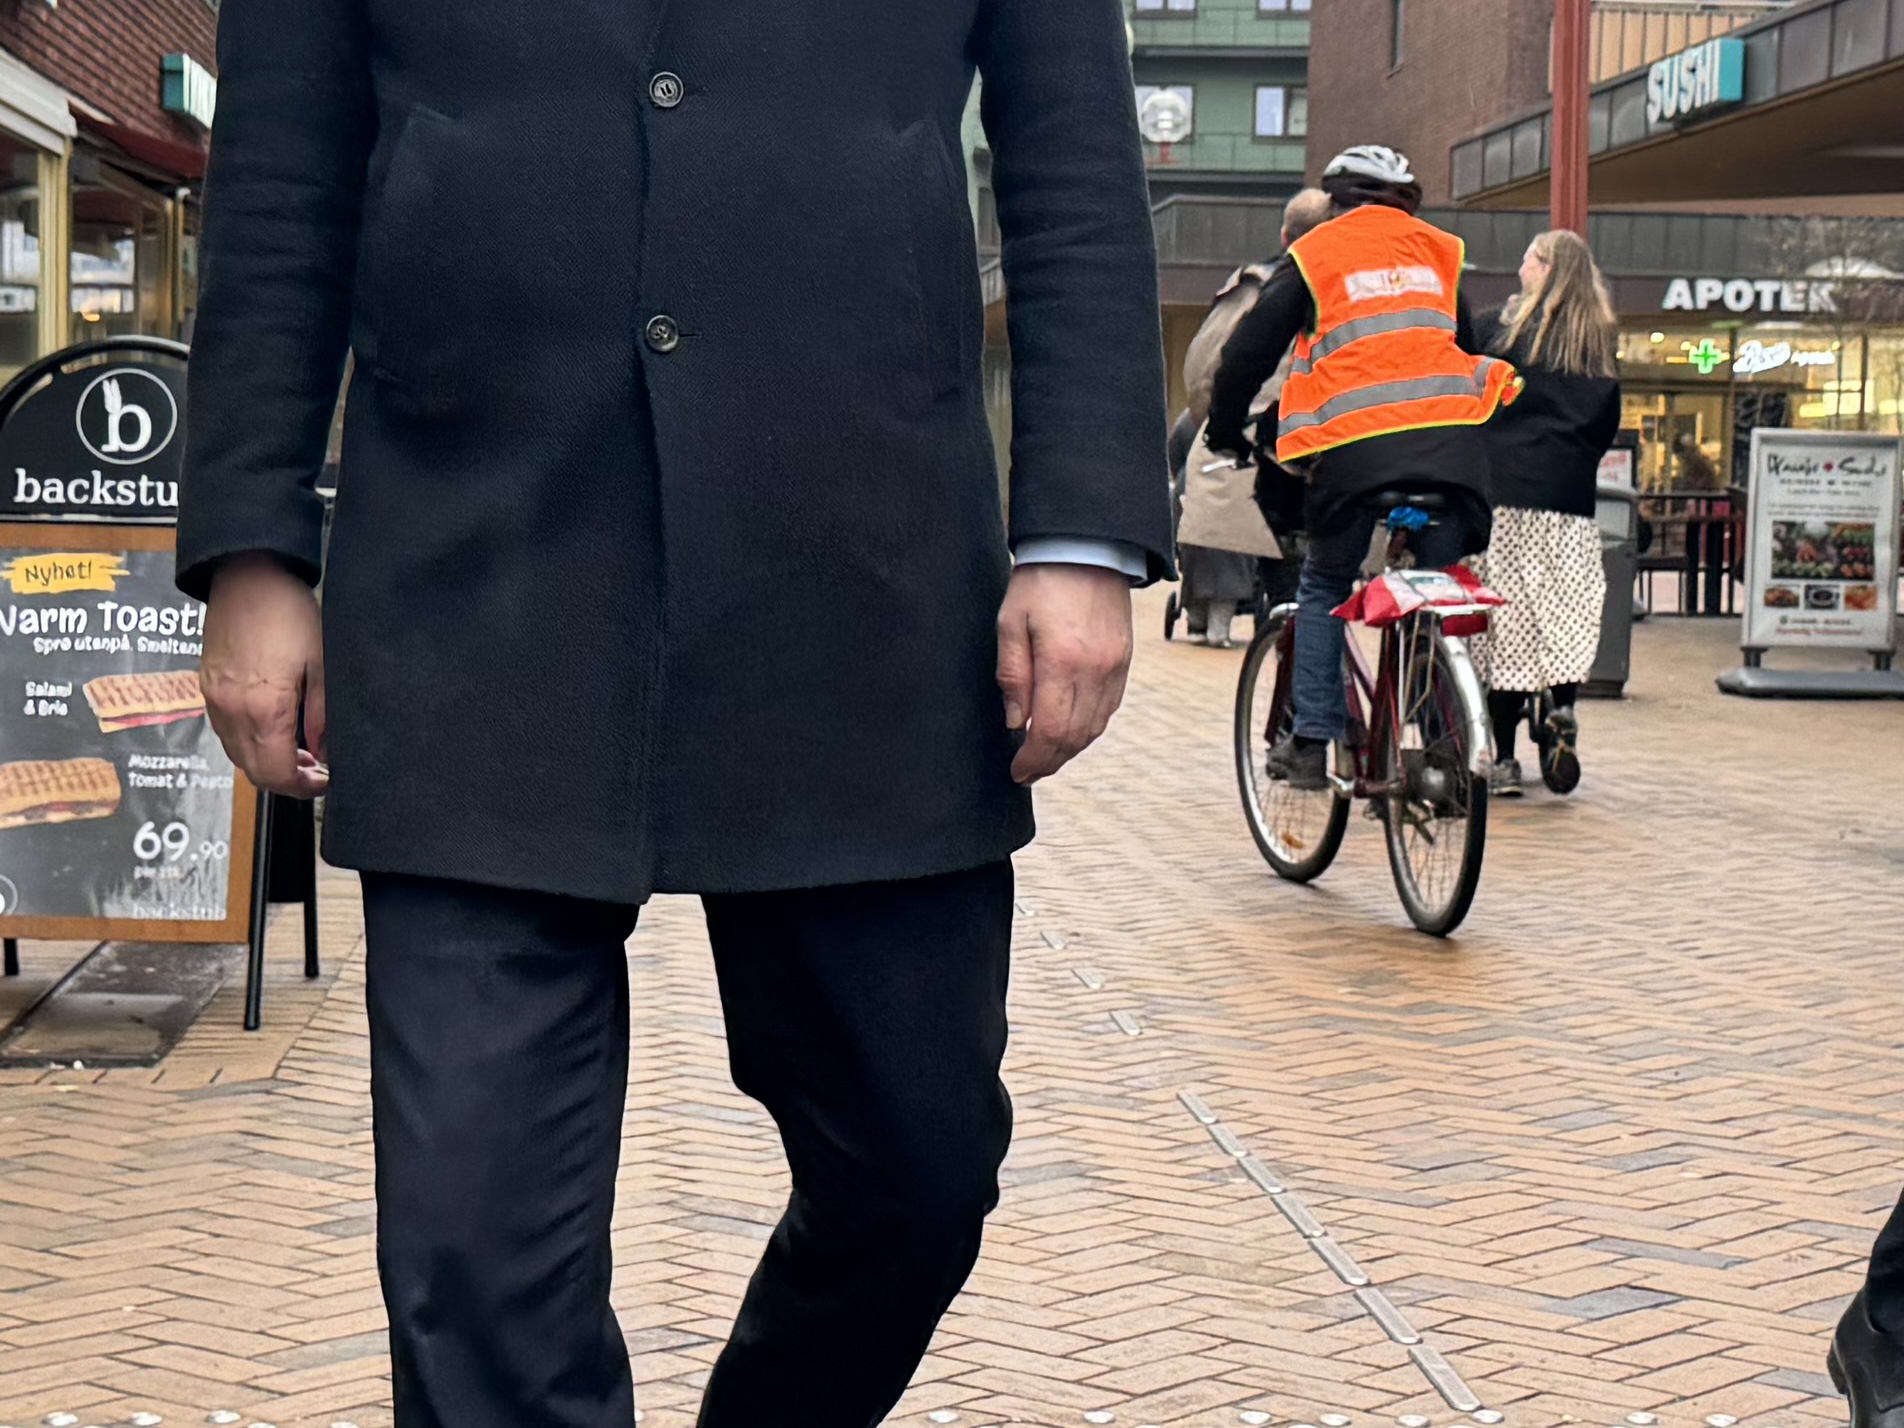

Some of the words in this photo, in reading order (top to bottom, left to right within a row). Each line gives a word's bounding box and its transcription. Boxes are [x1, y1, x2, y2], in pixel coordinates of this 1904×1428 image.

[1646, 38, 1720, 124] SUSHI
[1662, 278, 1837, 312] APOTEK
[13, 468, 179, 507] backstu
[24, 561, 93, 586] Nyhet!
[97, 600, 208, 636] Toast!
[128, 771, 174, 789] Tomat
[176, 772, 188, 789] &
[133, 821, 229, 862] 69.90
